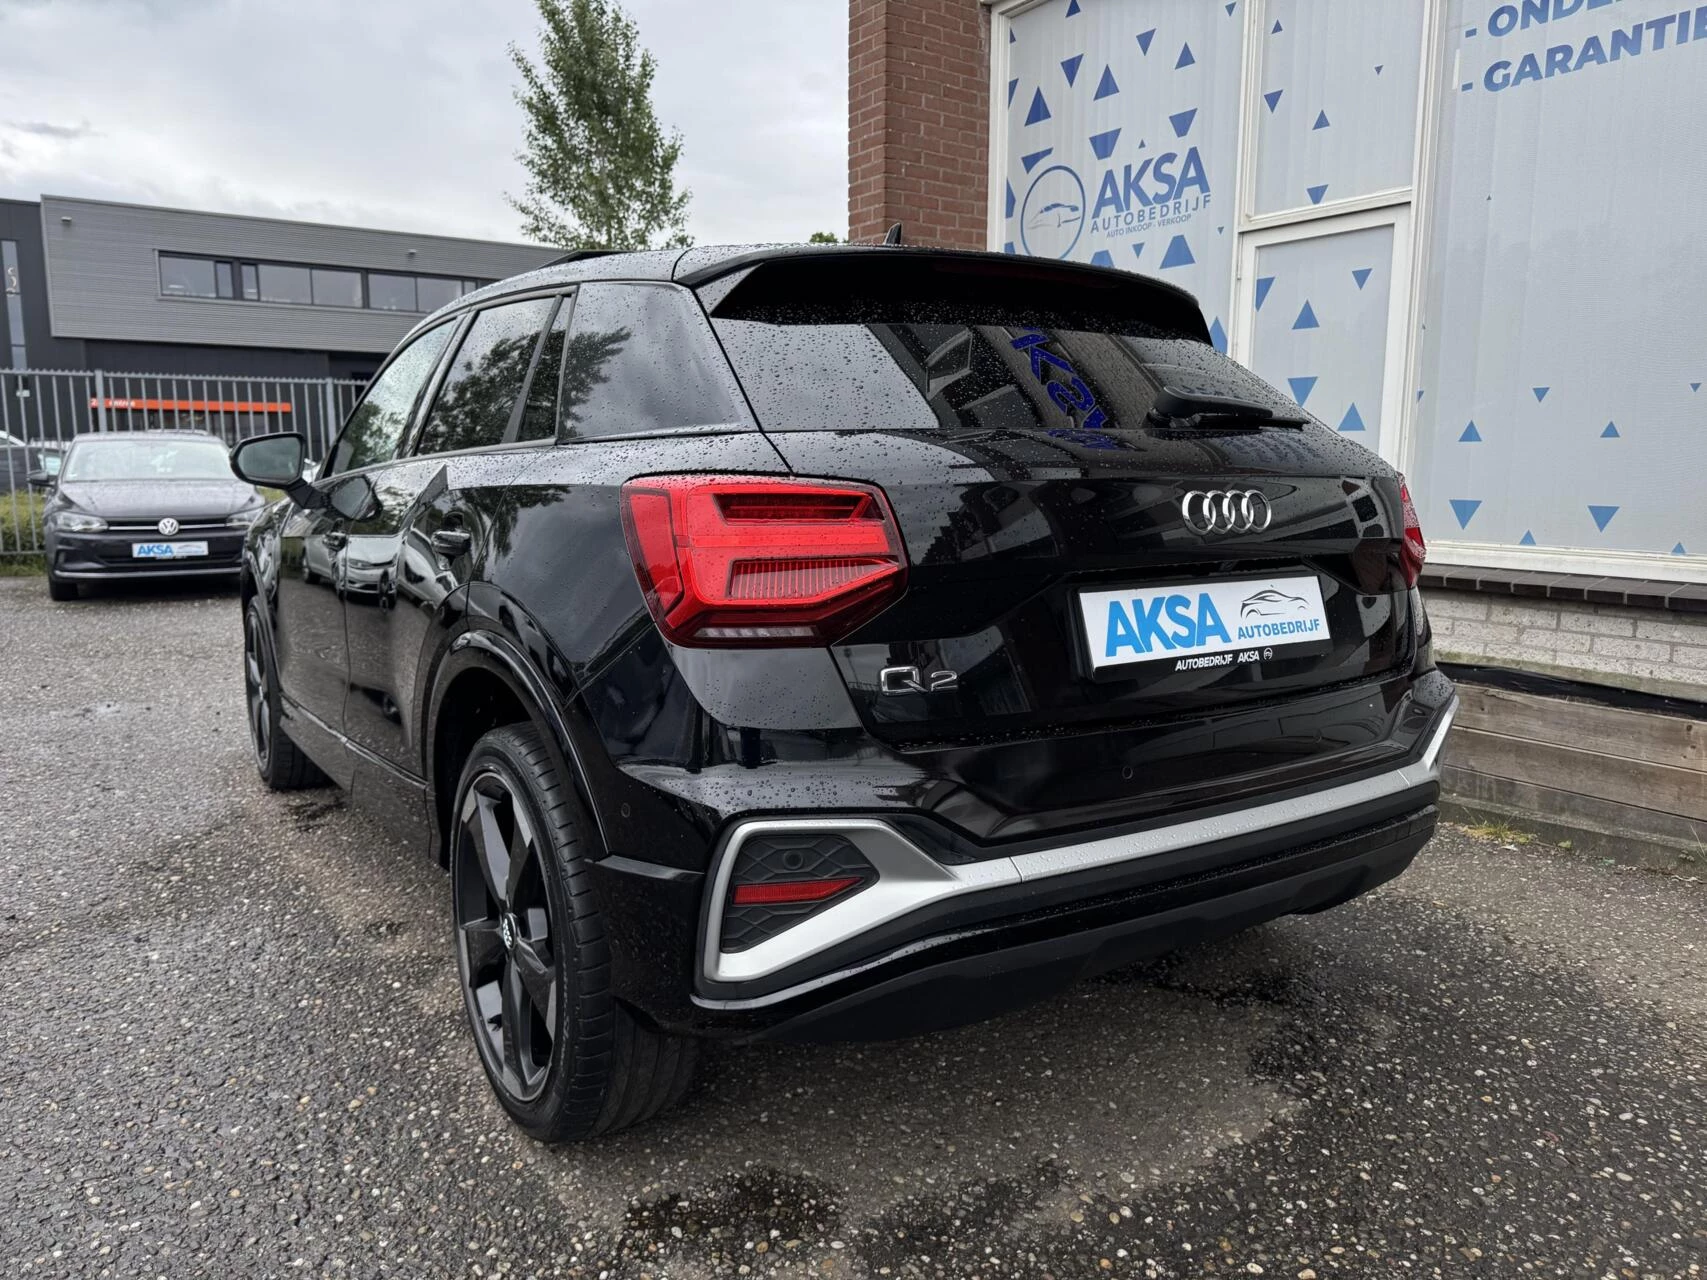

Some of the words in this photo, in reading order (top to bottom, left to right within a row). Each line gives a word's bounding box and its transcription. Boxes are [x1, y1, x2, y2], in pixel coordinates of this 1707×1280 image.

[1487, 0, 1621, 37] OND
[1091, 146, 1211, 220] AKSA
[1090, 194, 1212, 234] AUTOBEDRIJF
[1106, 229, 1125, 239] AUTO
[1125, 222, 1153, 235] INKOOP
[1157, 213, 1192, 228] VERKOOP
[138, 544, 174, 556] AKSA
[1105, 592, 1232, 657] AKSA
[1237, 618, 1321, 640] AUTOBEDRIJF
[1175, 654, 1233, 671] AUTOBEDRIJF
[1237, 650, 1260, 664] AKSA
[880, 666, 959, 695] Q2
